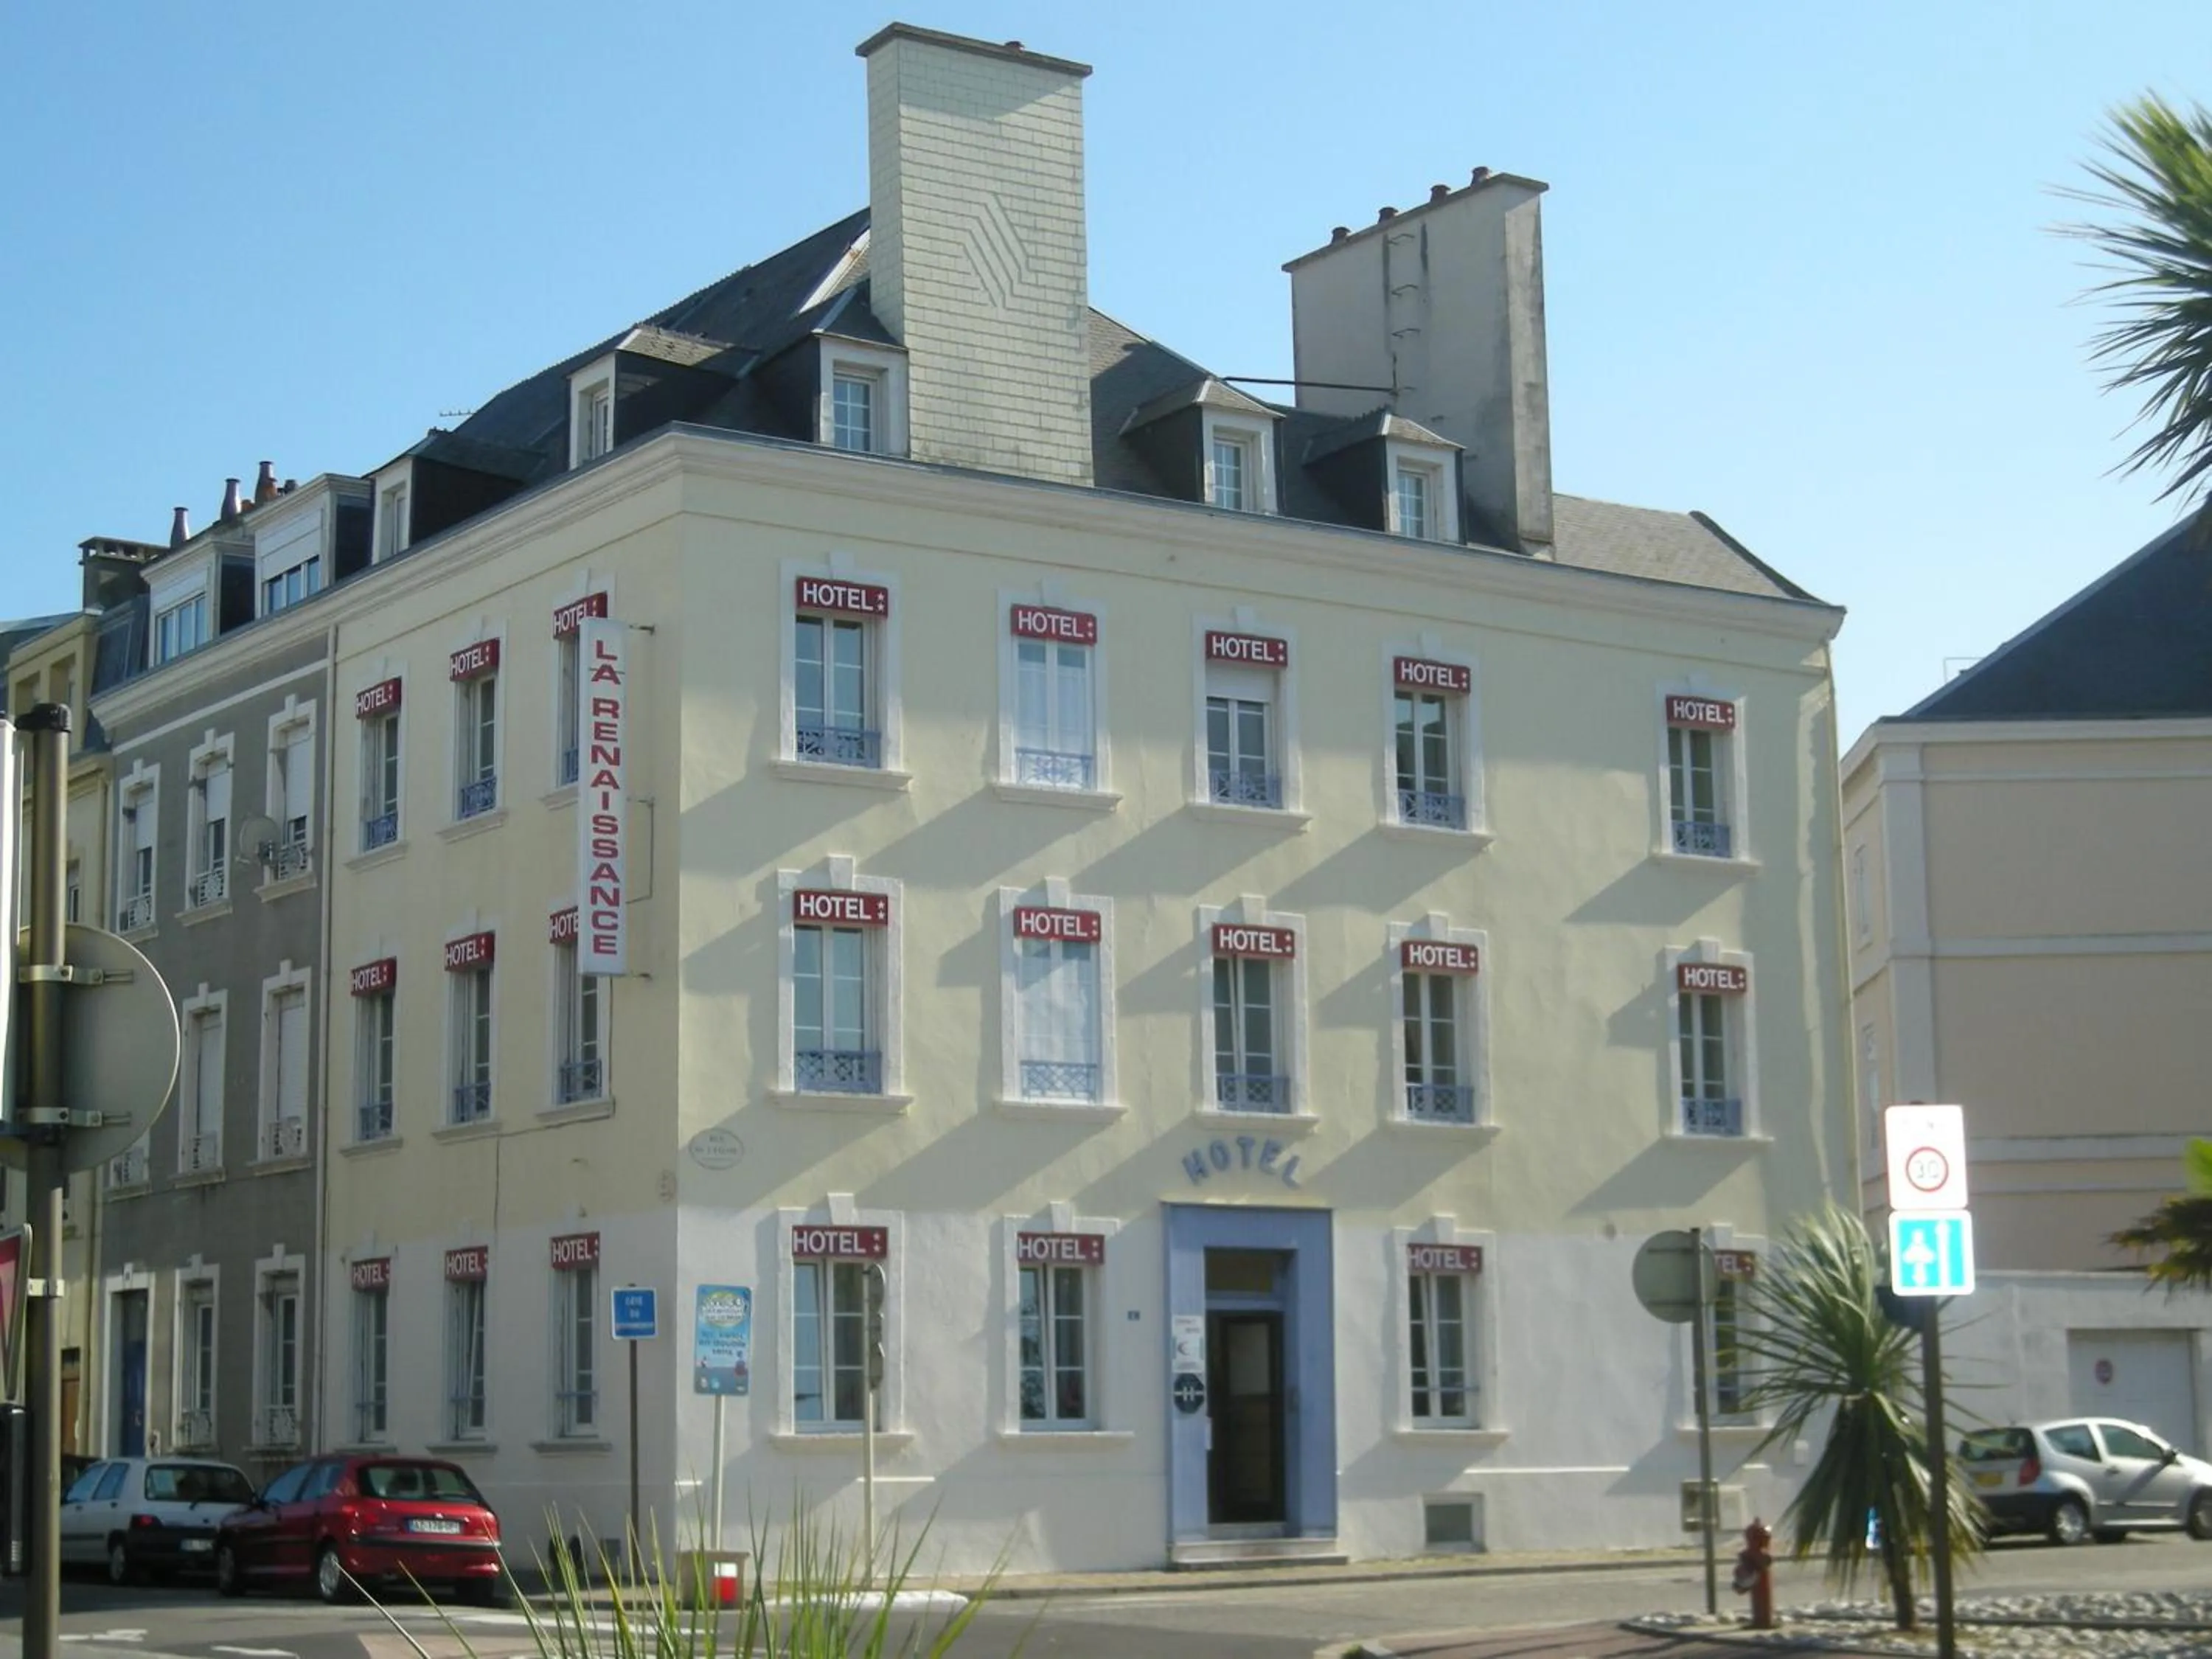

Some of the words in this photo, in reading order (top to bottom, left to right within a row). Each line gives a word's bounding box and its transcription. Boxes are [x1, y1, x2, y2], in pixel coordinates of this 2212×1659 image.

[802, 582, 874, 611] HOTEL
[1018, 611, 1083, 638] HOTEL
[1211, 636, 1275, 662] HOTEL
[450, 647, 484, 678] HOTEL
[591, 640, 621, 685] LA
[1401, 661, 1459, 688] HOTEL
[355, 688, 387, 713] HOTEL
[1673, 700, 1725, 723] HOTEL
[590, 697, 621, 956] RENAISSANCE
[800, 894, 872, 920] HOTEL
[550, 911, 578, 939] HOTE
[1020, 911, 1088, 937] HOTEL
[446, 940, 479, 964] HOTEL
[1220, 928, 1283, 953] HOTEL
[1409, 944, 1468, 969] HOTEL
[353, 967, 383, 991] HOTEL
[1684, 967, 1738, 989] HOTEL
[1181, 1135, 1301, 1191] HOTEL
[552, 1239, 591, 1263] HOTEL
[793, 1230, 866, 1253] HOTEL
[1018, 1238, 1086, 1259] HOTEL
[446, 1252, 480, 1275] HOTEL
[1408, 1248, 1467, 1270] HOTEL
[352, 1262, 384, 1283] HOTEL
